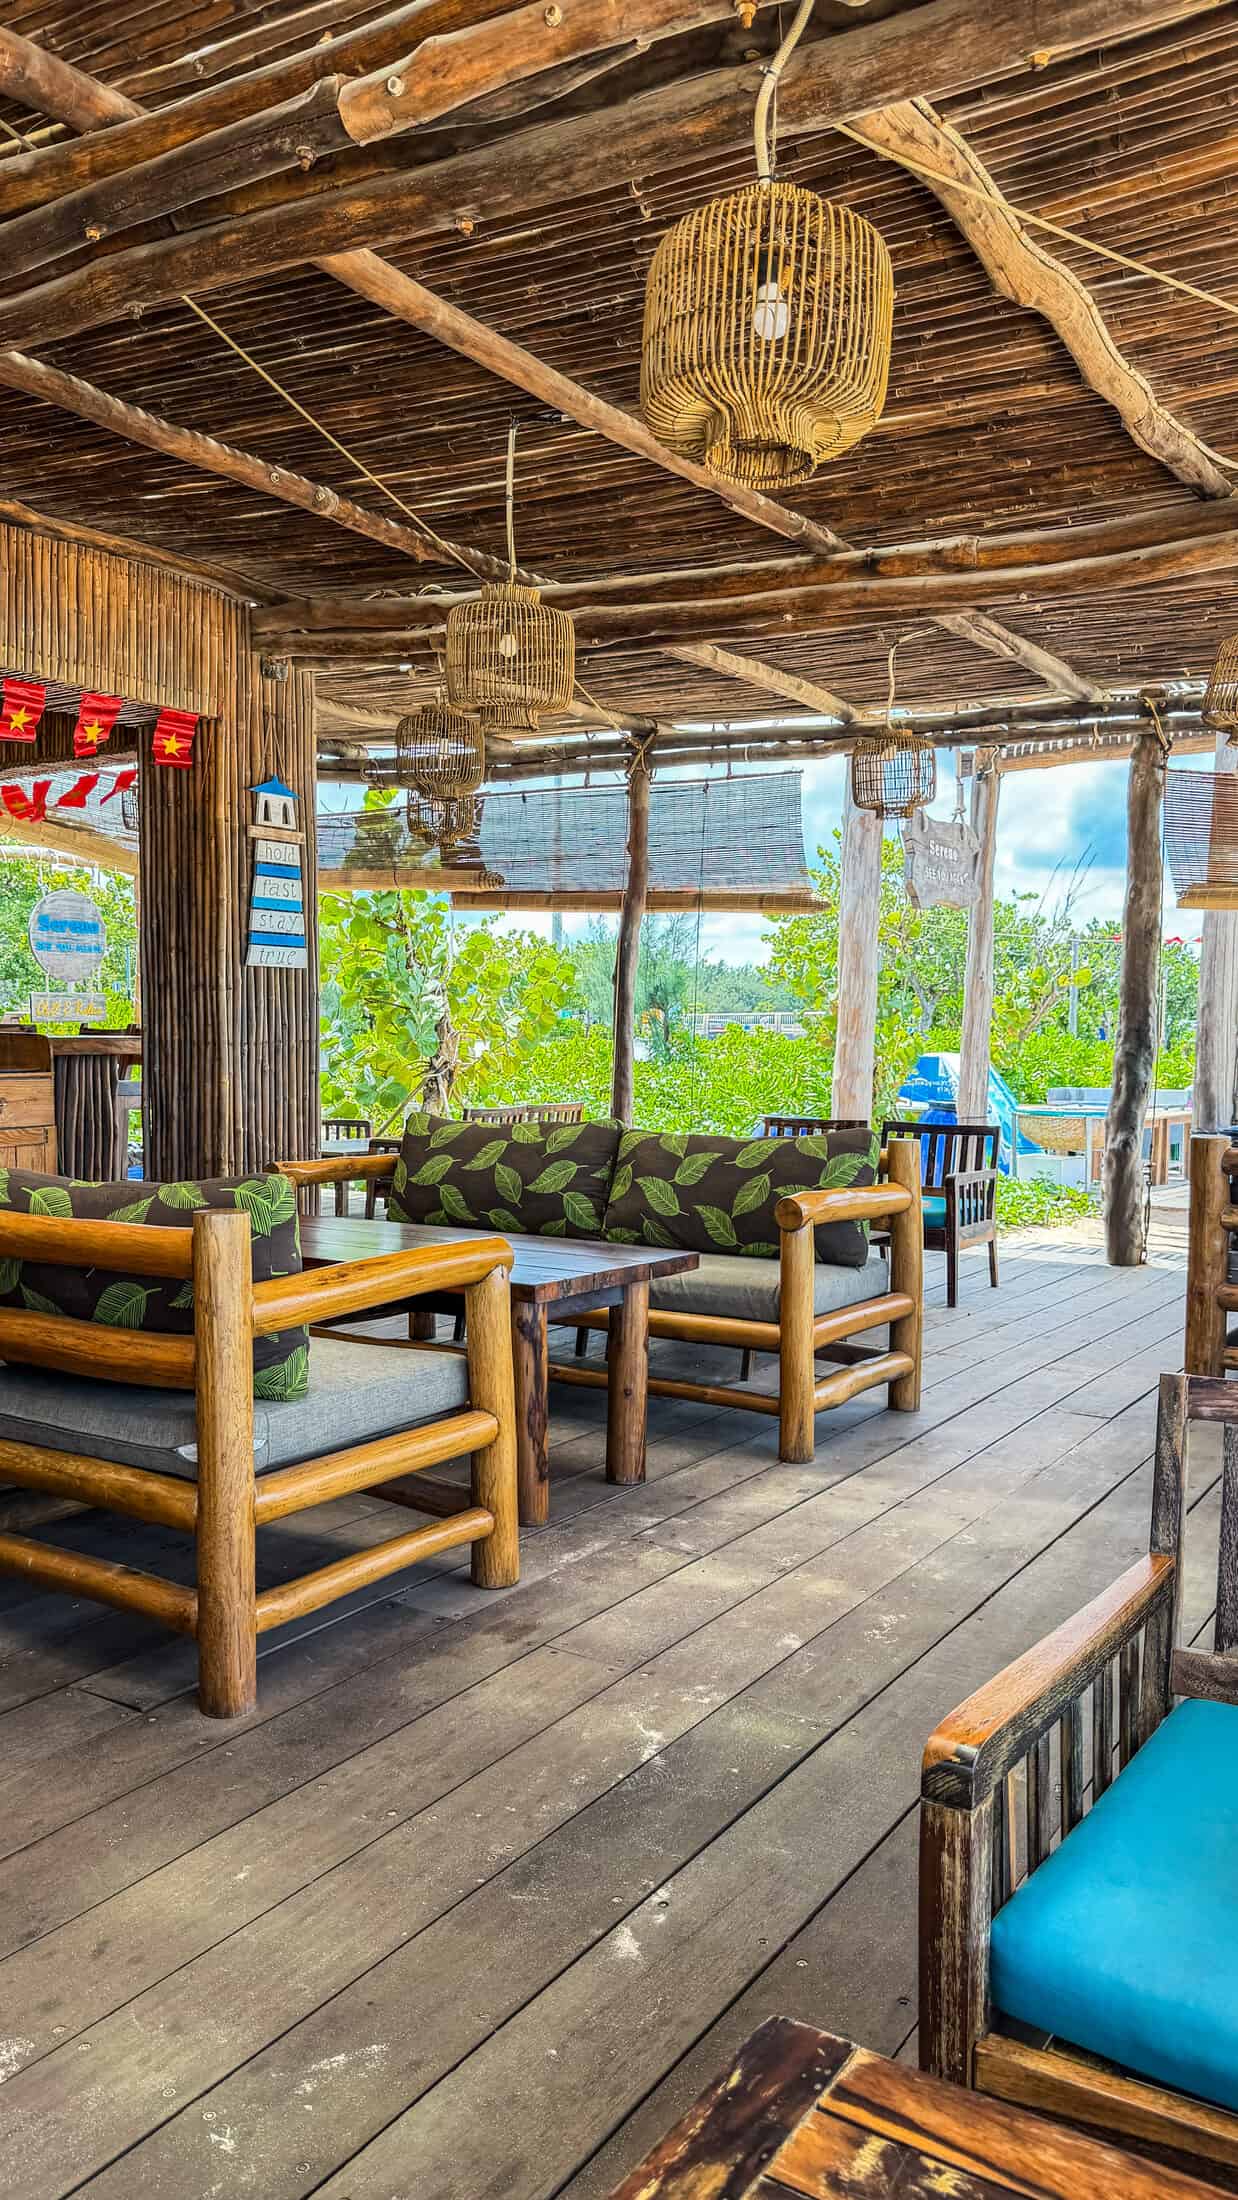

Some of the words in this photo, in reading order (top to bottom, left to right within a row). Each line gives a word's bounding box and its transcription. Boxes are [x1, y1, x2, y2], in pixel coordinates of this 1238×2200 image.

[265, 844, 296, 864] hold
[262, 879, 297, 898] fast
[259, 913, 299, 933] stay
[259, 948, 297, 965] true
